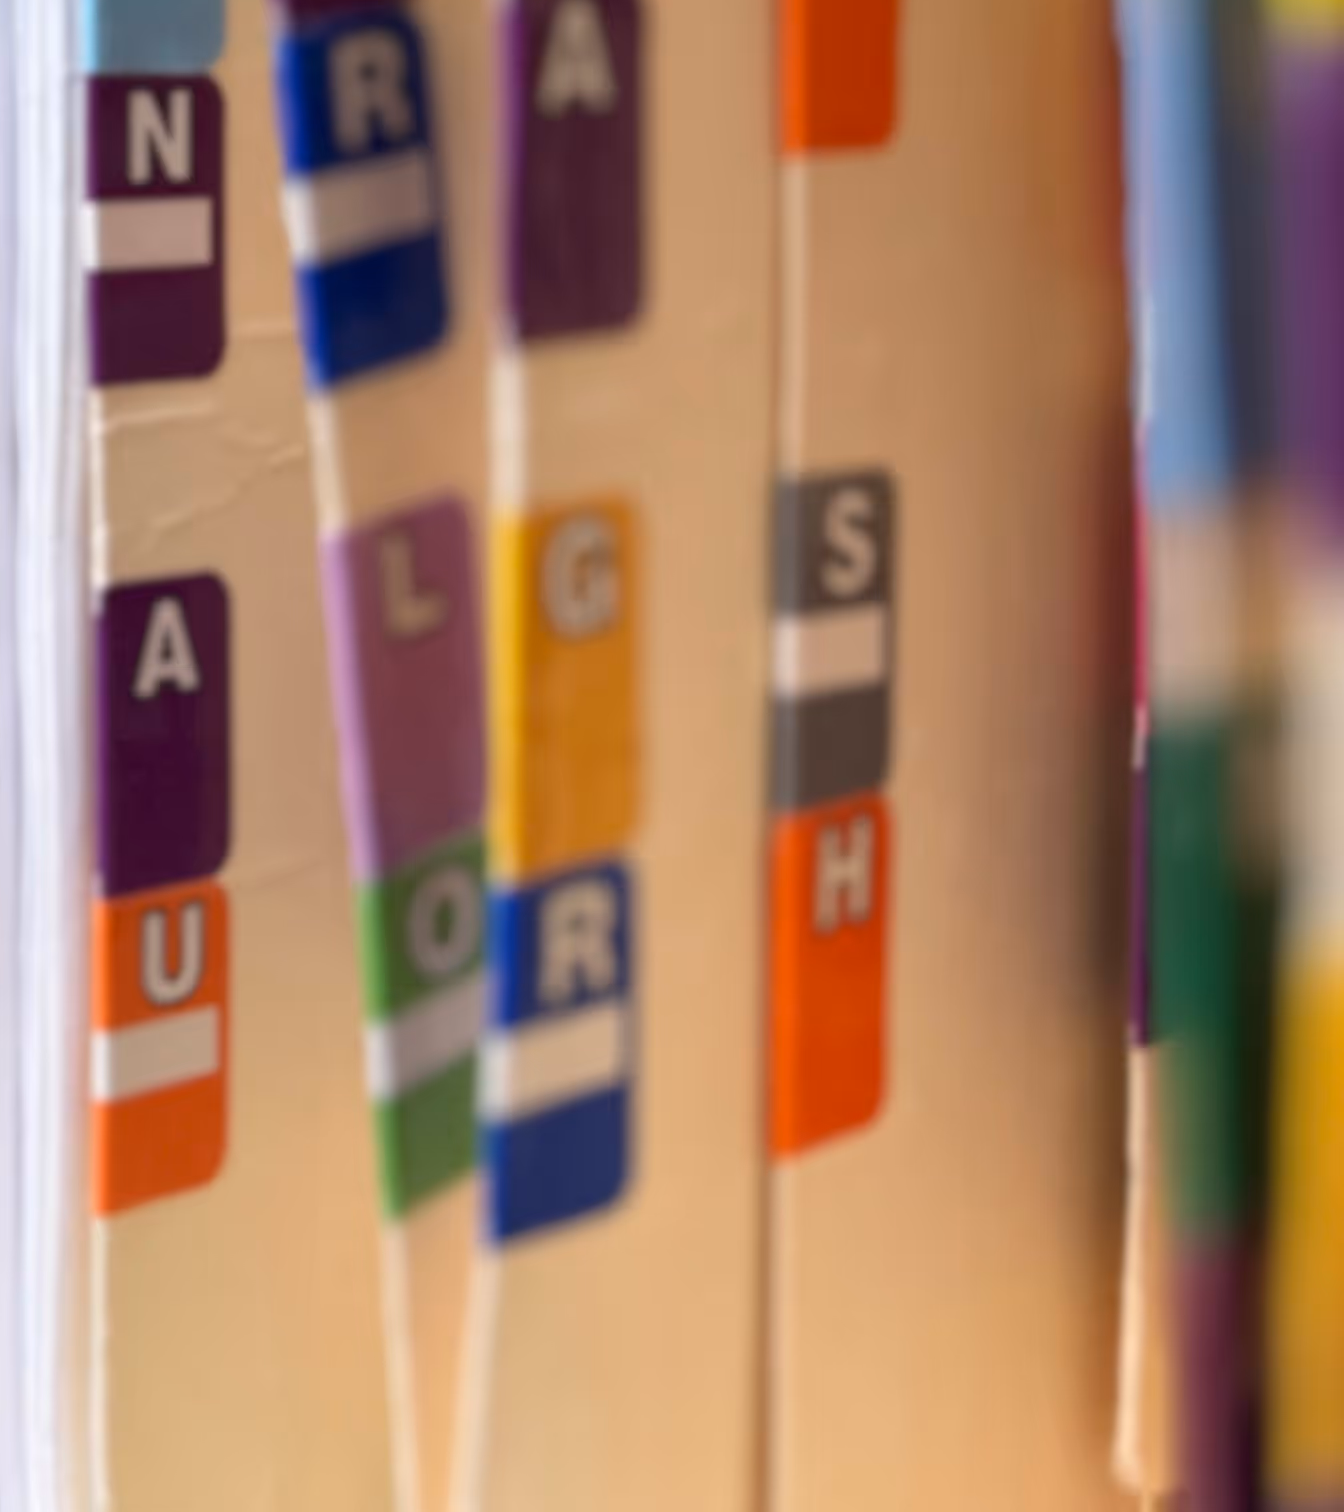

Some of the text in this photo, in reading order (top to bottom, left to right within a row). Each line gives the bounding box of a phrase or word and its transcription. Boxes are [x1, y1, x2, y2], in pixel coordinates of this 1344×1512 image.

[127, 89, 193, 184] N
[327, 29, 414, 155] R
[378, 530, 449, 640] L
[542, 515, 620, 641] G
[821, 487, 878, 600] S
[133, 597, 201, 700] A
[406, 863, 482, 976] O
[813, 815, 875, 935] H
[139, 898, 204, 1007] U
[539, 876, 620, 1008] R
